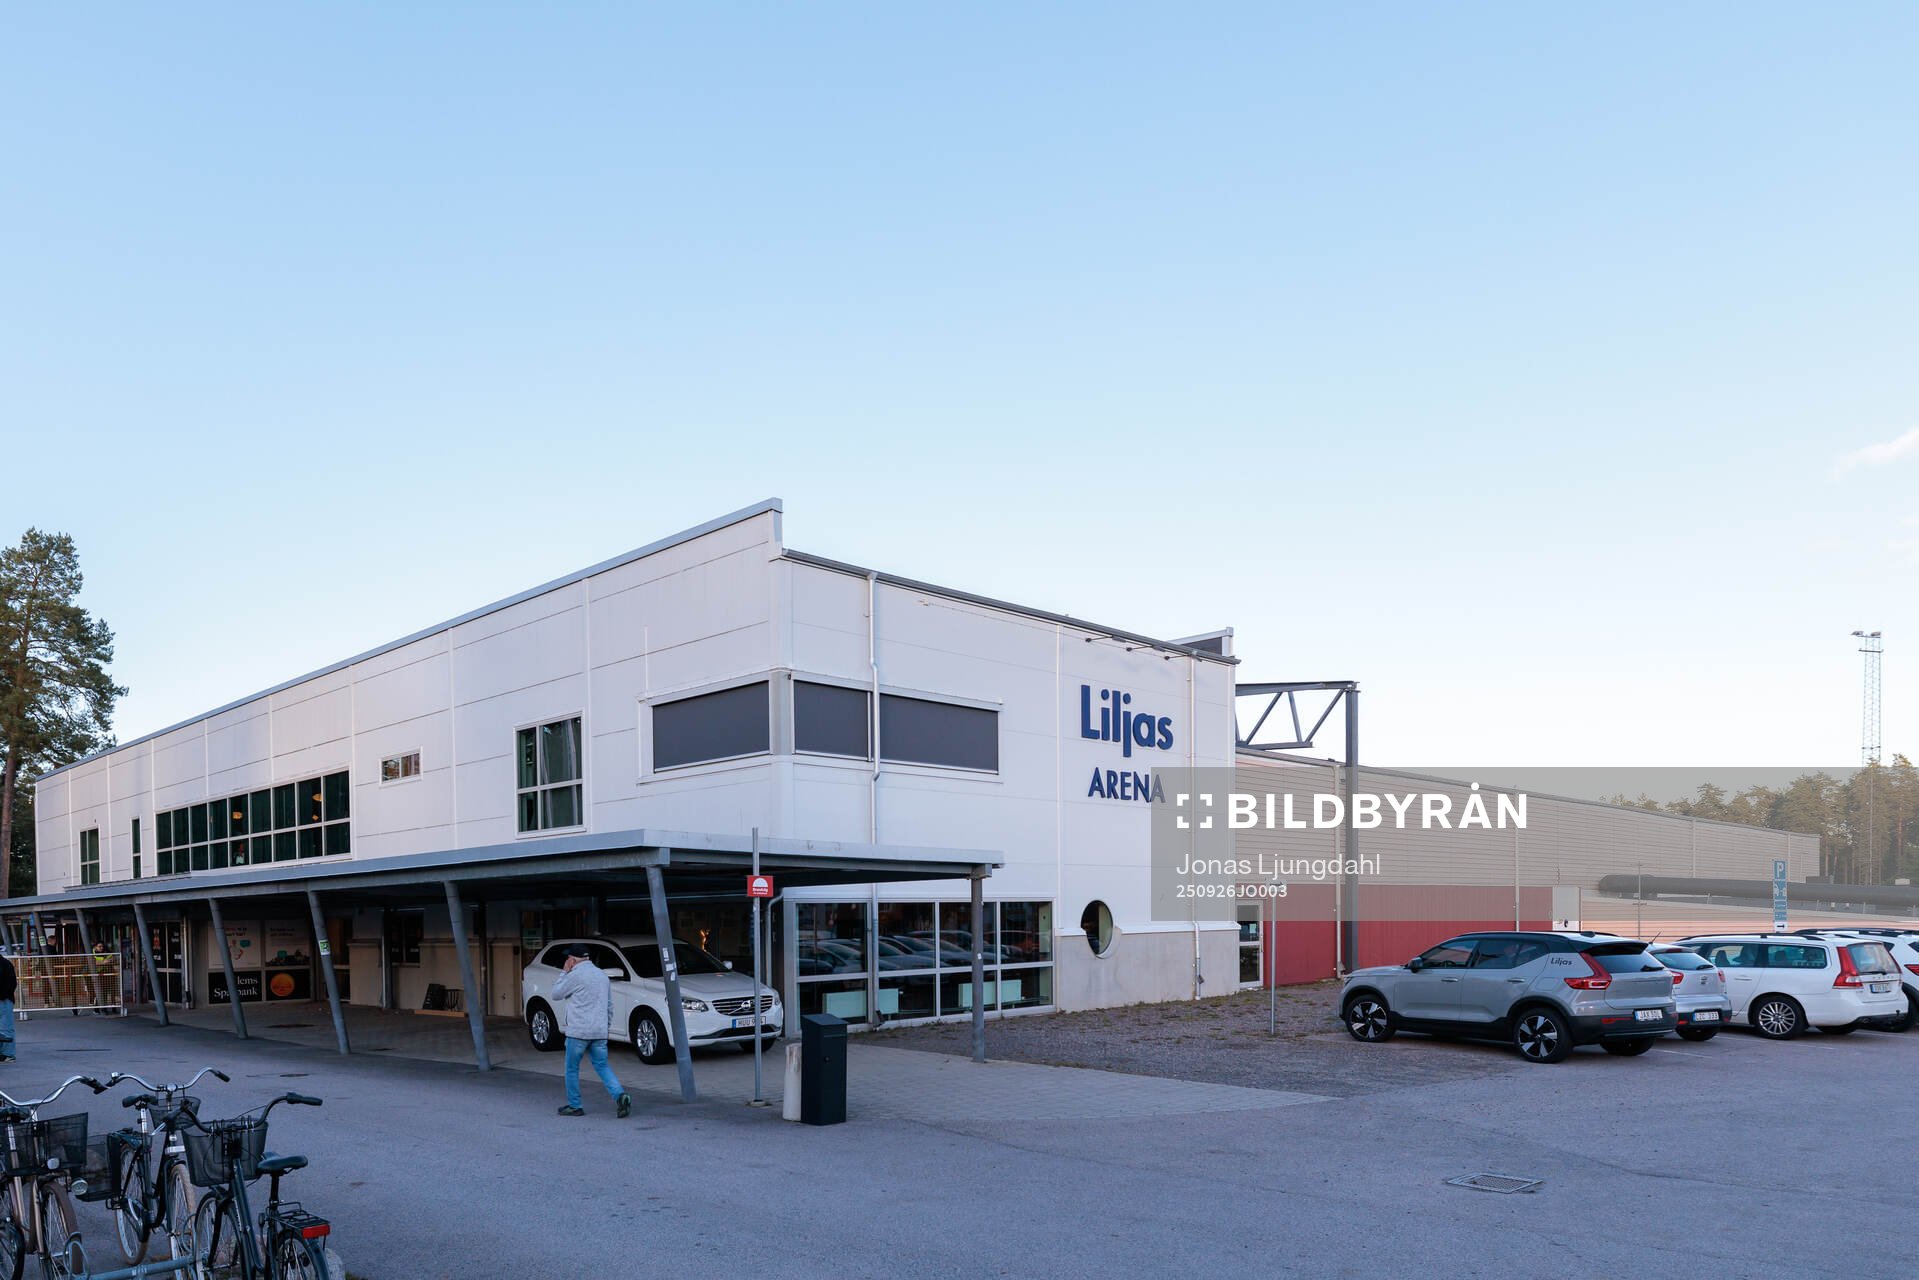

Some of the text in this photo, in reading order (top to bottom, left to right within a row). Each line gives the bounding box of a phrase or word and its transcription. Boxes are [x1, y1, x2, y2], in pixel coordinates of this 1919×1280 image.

[1081, 684, 1174, 758] Liljas
[1088, 767, 1167, 803] ARENA
[1776, 862, 1784, 878] P
[1551, 957, 1573, 966] Liljas
[236, 976, 258, 985] lems
[213, 987, 258, 999] Spank
